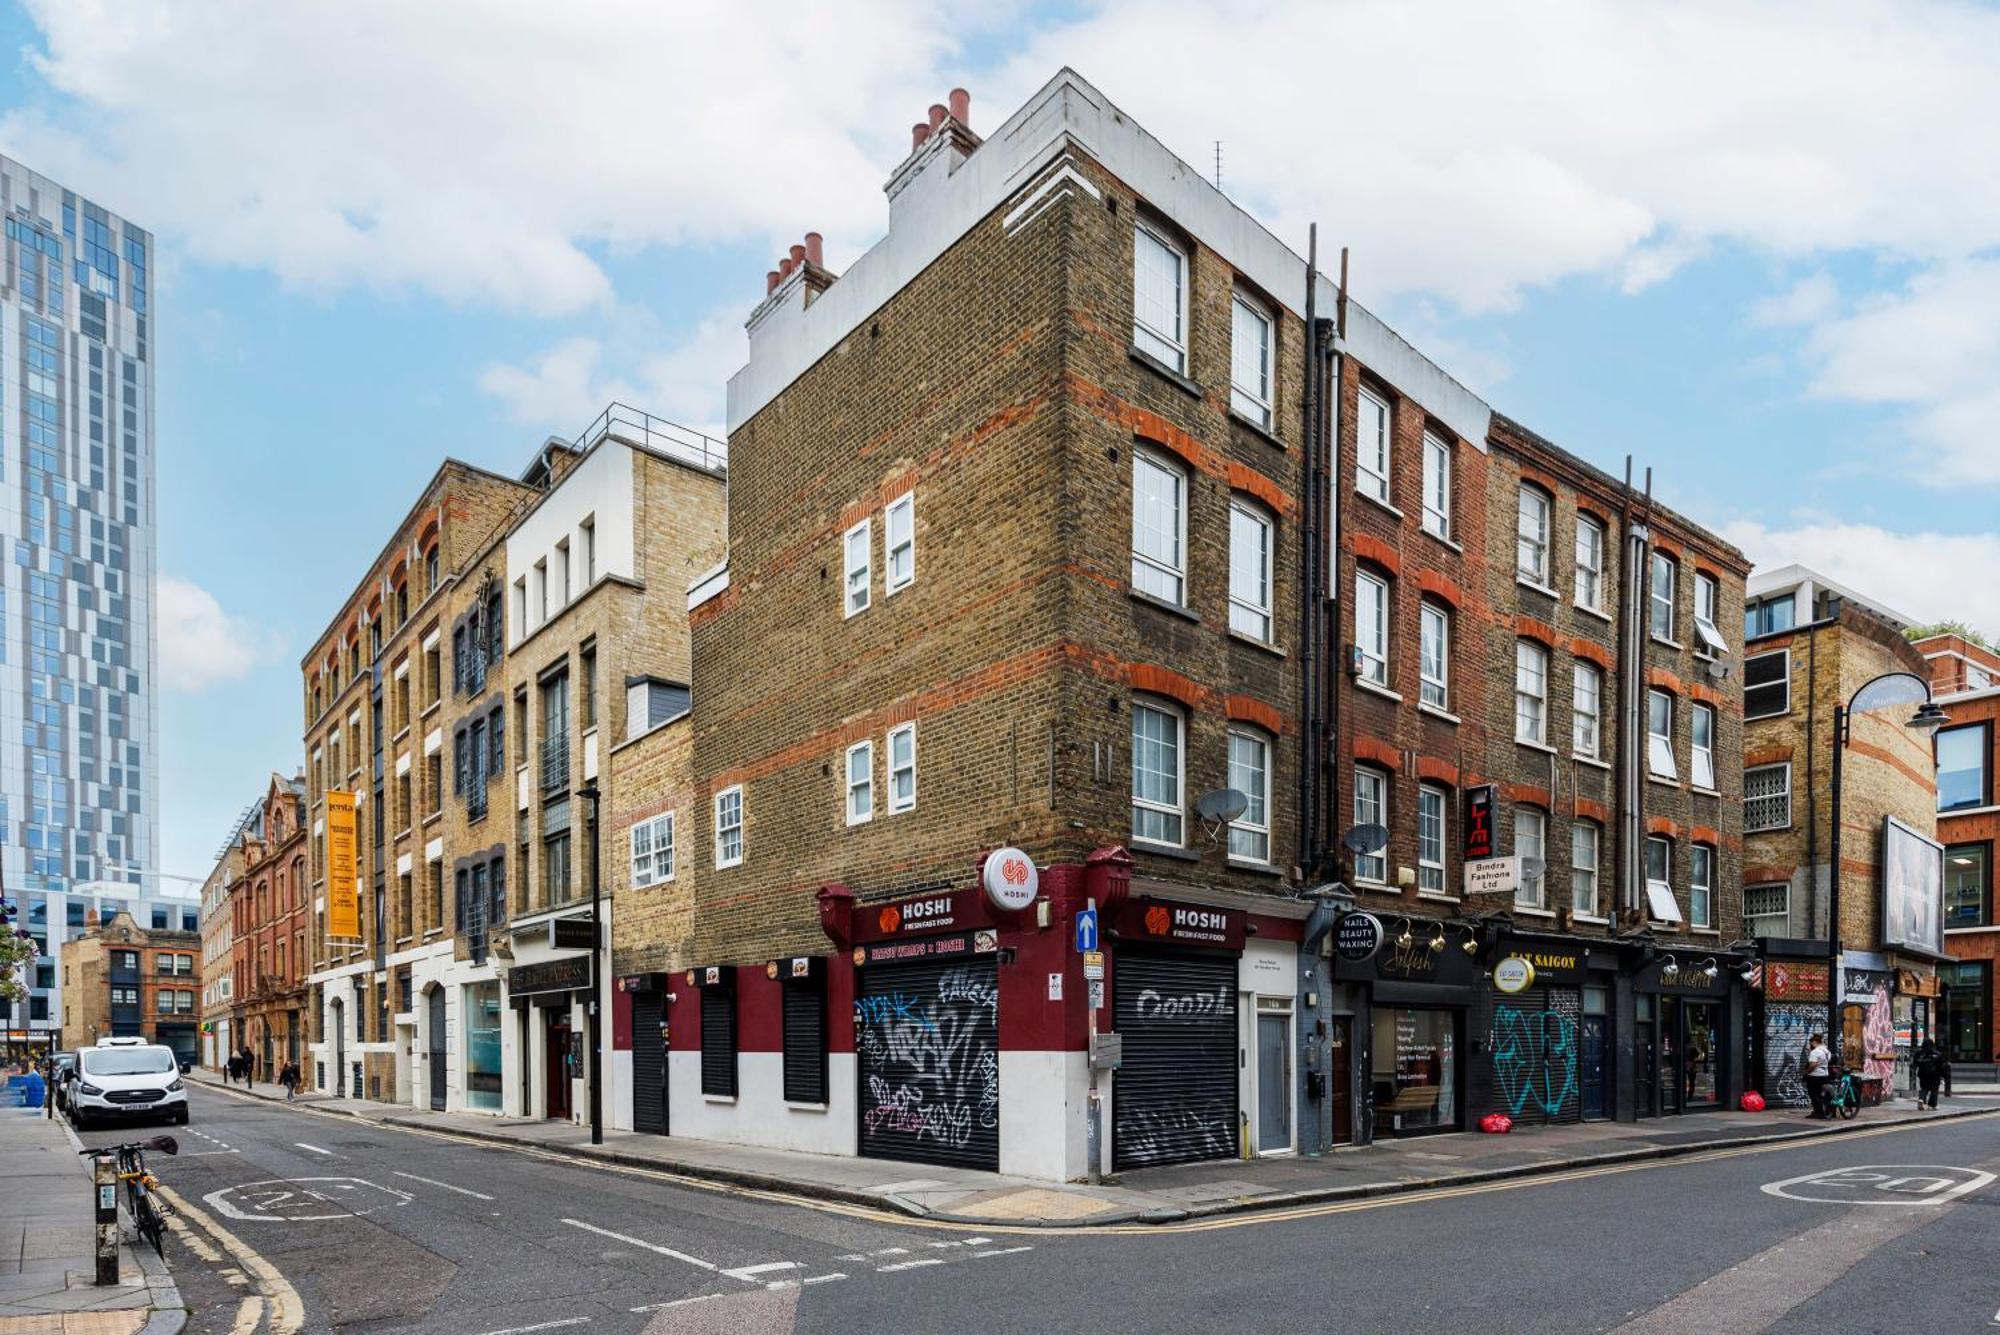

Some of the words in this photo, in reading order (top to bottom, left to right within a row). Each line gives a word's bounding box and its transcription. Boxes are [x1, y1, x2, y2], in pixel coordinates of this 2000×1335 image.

[1476, 862, 1505, 871] Bindra
[1471, 871, 1510, 881] Fashions
[1483, 880, 1497, 889] Ltd
[1004, 890, 1029, 899] HOSHI
[903, 897, 952, 919] HOSHI
[904, 922, 922, 931] FRESH
[922, 920, 936, 928] FAST
[937, 917, 954, 926] FOOD
[1174, 908, 1227, 930] HOSHI
[1344, 918, 1369, 927] NAILS
[1173, 929, 1193, 938] FRESH
[1193, 932, 1208, 940] FAST
[1209, 933, 1226, 942] FOOD
[1340, 929, 1373, 939] BEAUTY
[935, 938, 965, 954] HOSHI
[1338, 940, 1374, 949] WAXING
[1534, 954, 1576, 969] SAIGON
[1806, 1173, 1955, 1193] 20
